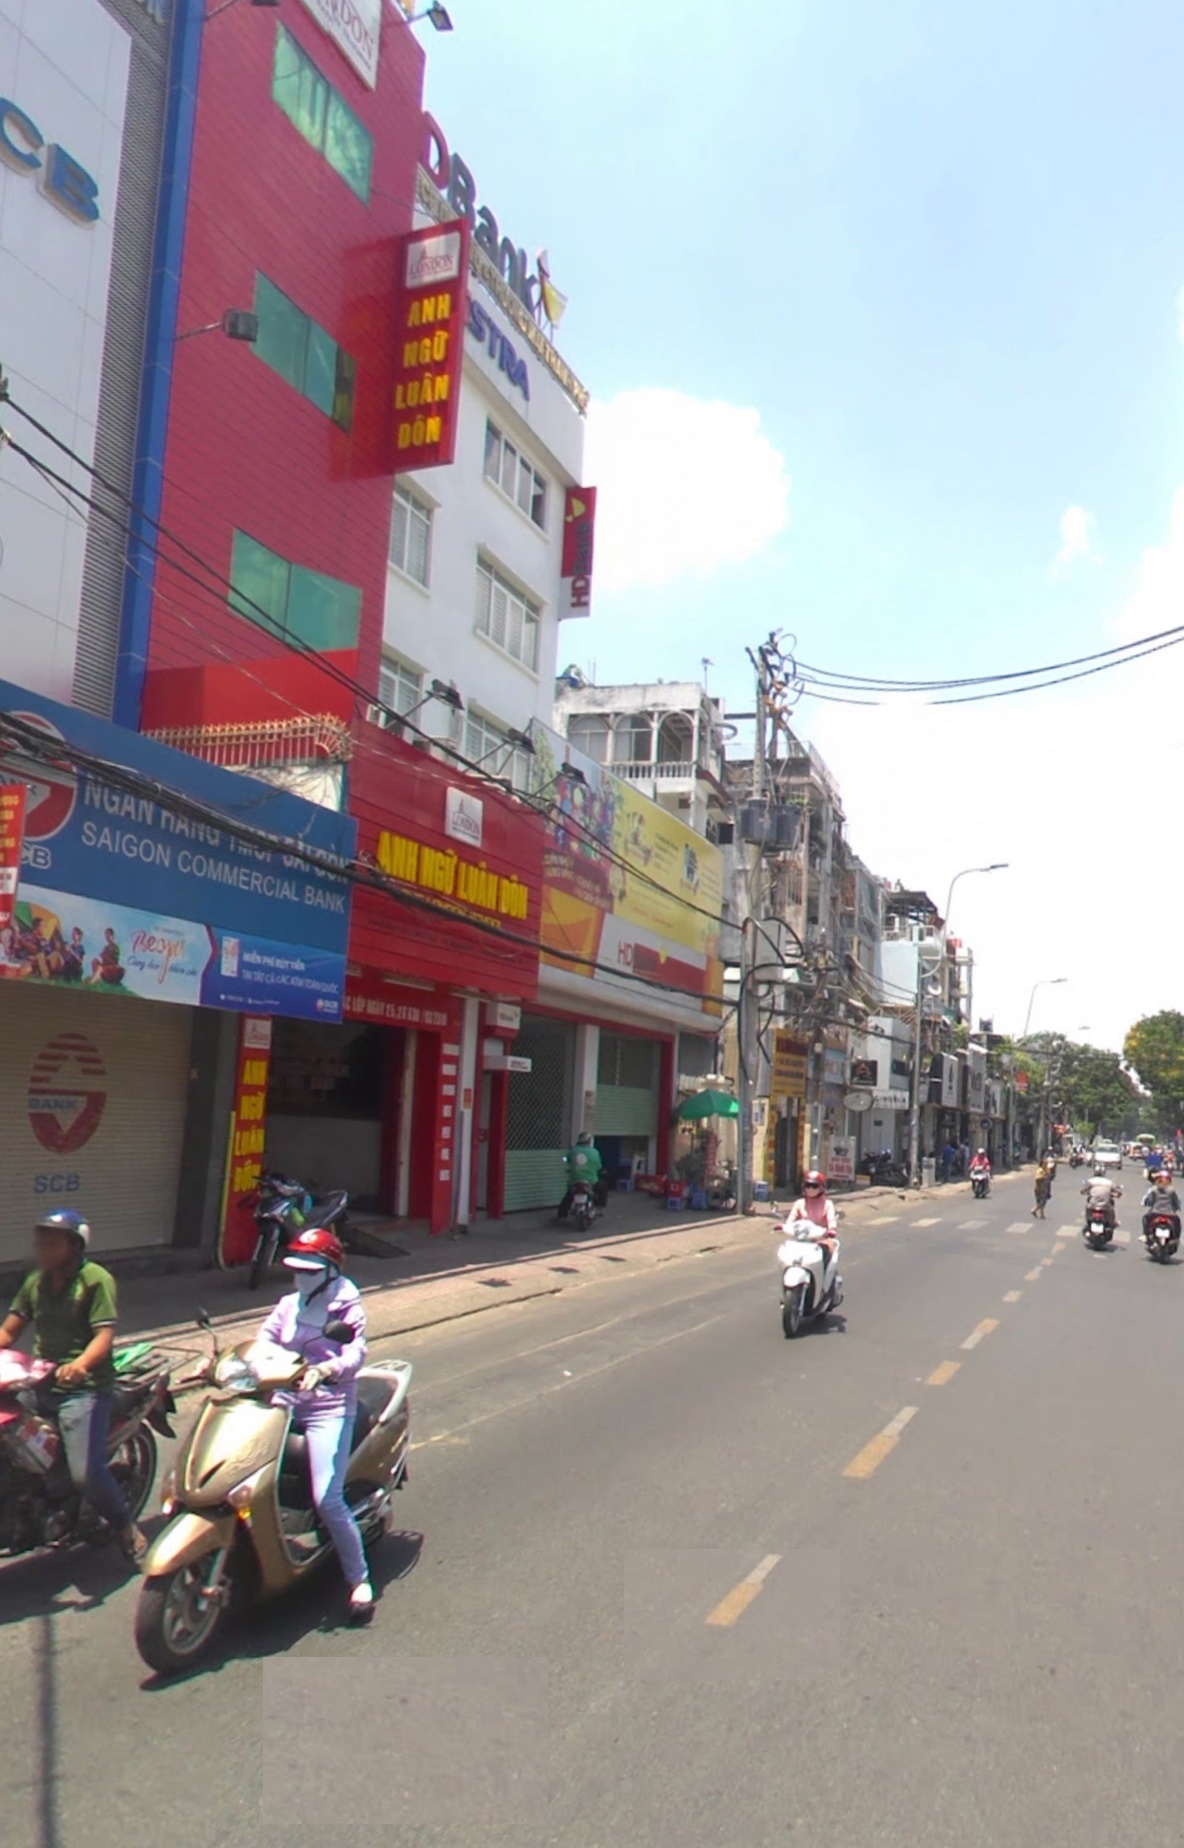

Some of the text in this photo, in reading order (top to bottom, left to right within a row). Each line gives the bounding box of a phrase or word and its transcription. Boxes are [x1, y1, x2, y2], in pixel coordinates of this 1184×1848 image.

[0, 97, 99, 222] CB
[410, 254, 453, 276] LONDON
[407, 294, 451, 329] ANH
[402, 330, 449, 369] NGỮ
[466, 293, 531, 402] STRA
[395, 372, 450, 411] LUÂN
[397, 414, 442, 451] ĐÔN
[80, 820, 345, 914] SAIGON COMMERCIAL BANK
[376, 831, 419, 883] ANH
[418, 848, 458, 896] NGỮ
[456, 860, 499, 911] LUÂN
[243, 1060, 267, 1085] ANH
[239, 1091, 266, 1120] NGỮ
[234, 1125, 266, 1156] LUÂN
[34, 1174, 81, 1194] SCB
